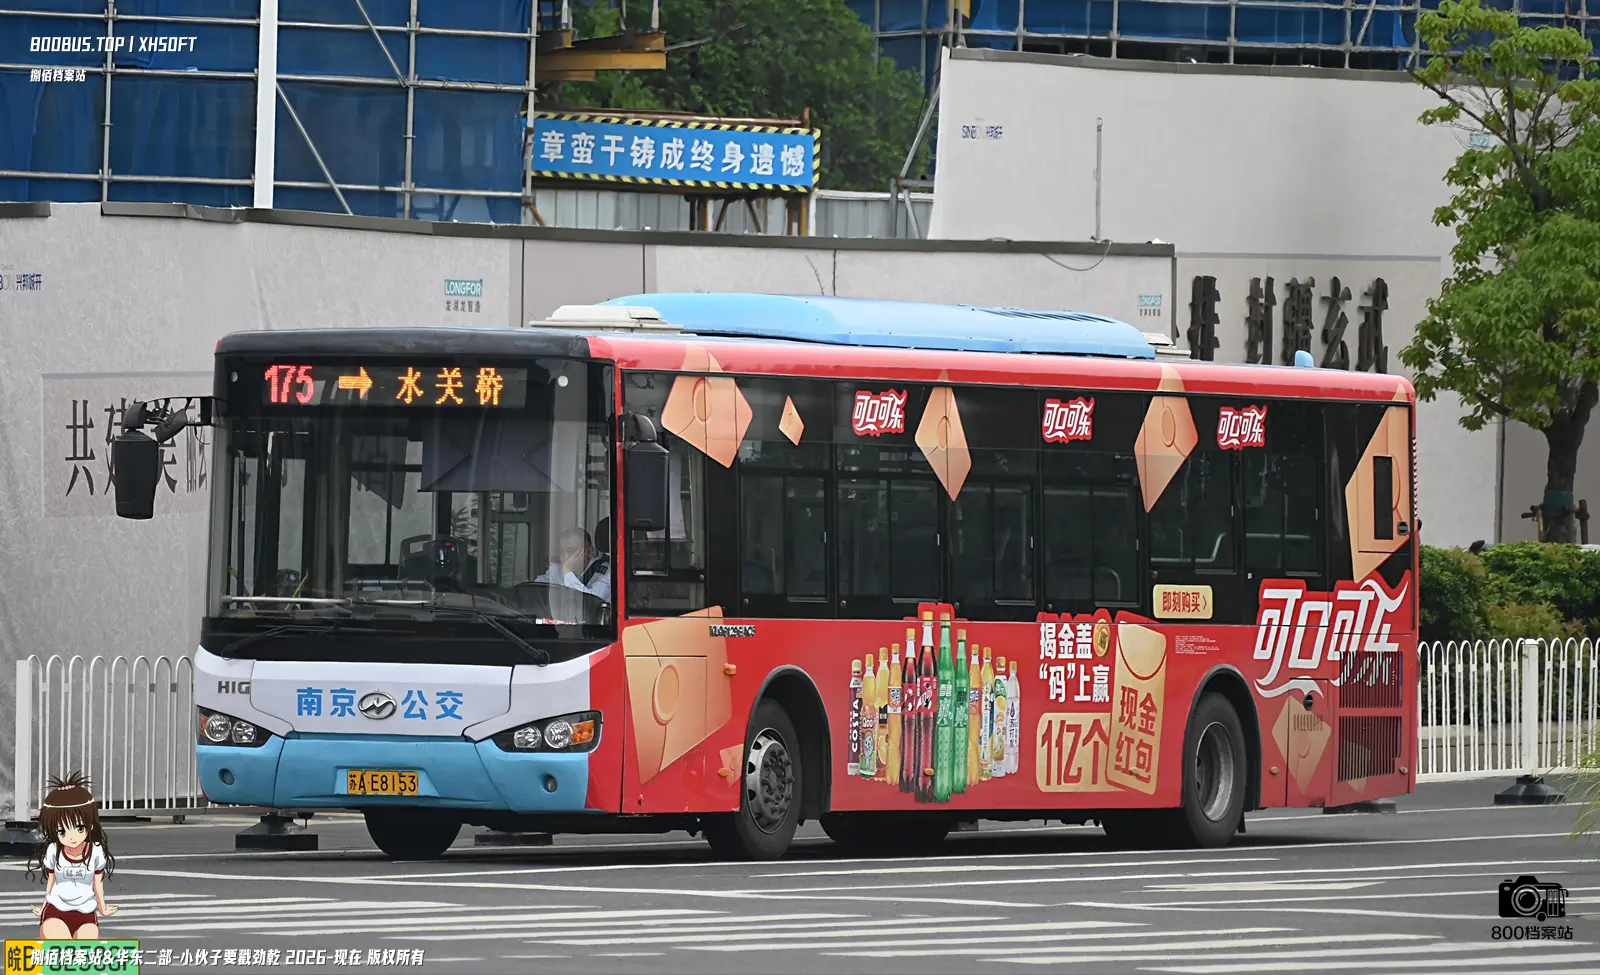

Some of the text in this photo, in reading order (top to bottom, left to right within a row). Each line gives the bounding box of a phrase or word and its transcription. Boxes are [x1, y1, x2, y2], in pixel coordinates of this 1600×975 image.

[445, 280, 481, 296] LONGFOR
[264, 365, 504, 406] 175 水关桥
[854, 391, 905, 434] 可口可乐
[1043, 399, 1093, 439] 可口可乐
[1163, 591, 1200, 612] 即刻购买
[1040, 622, 1092, 660] 揭金盖
[297, 687, 463, 720] 南京 公交
[1118, 685, 1158, 737] 现金
[852, 698, 860, 753] COSTA
[1041, 718, 1110, 787] 1亿个
[1114, 731, 1153, 784] 红包
